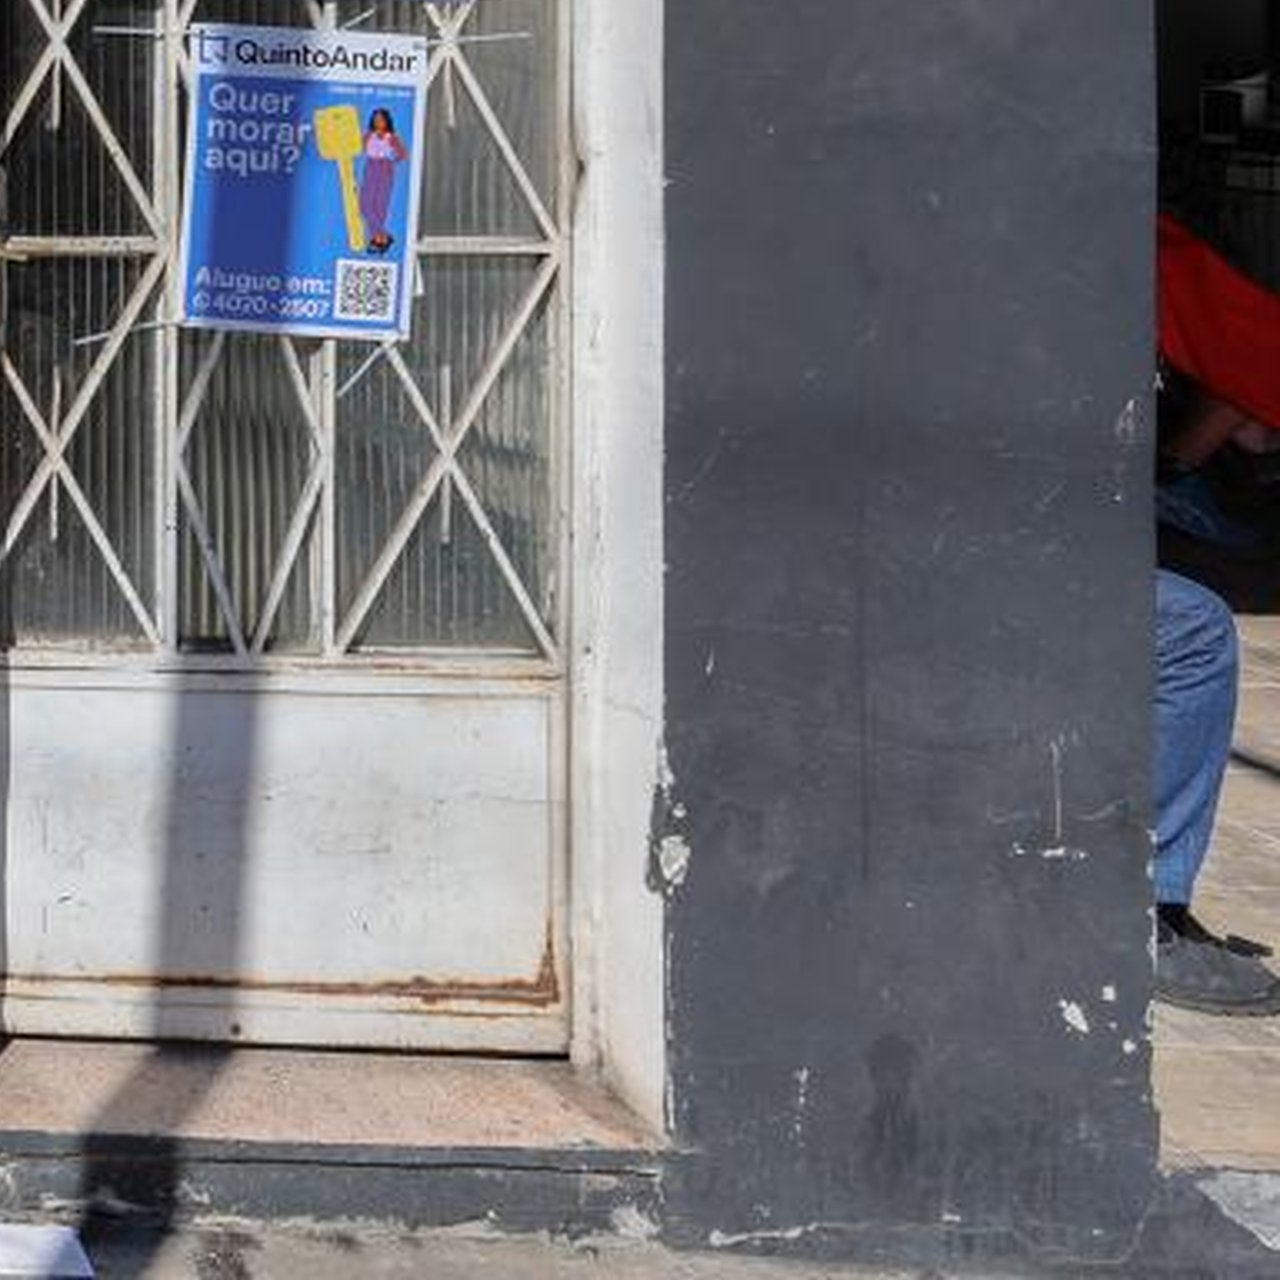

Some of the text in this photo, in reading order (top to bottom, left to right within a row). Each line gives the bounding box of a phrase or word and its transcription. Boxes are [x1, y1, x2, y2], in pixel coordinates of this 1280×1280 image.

[235, 39, 417, 71] QuintoAndar
[209, 82, 295, 114] Quer
[207, 119, 312, 144] morar
[205, 145, 300, 177] aqui?
